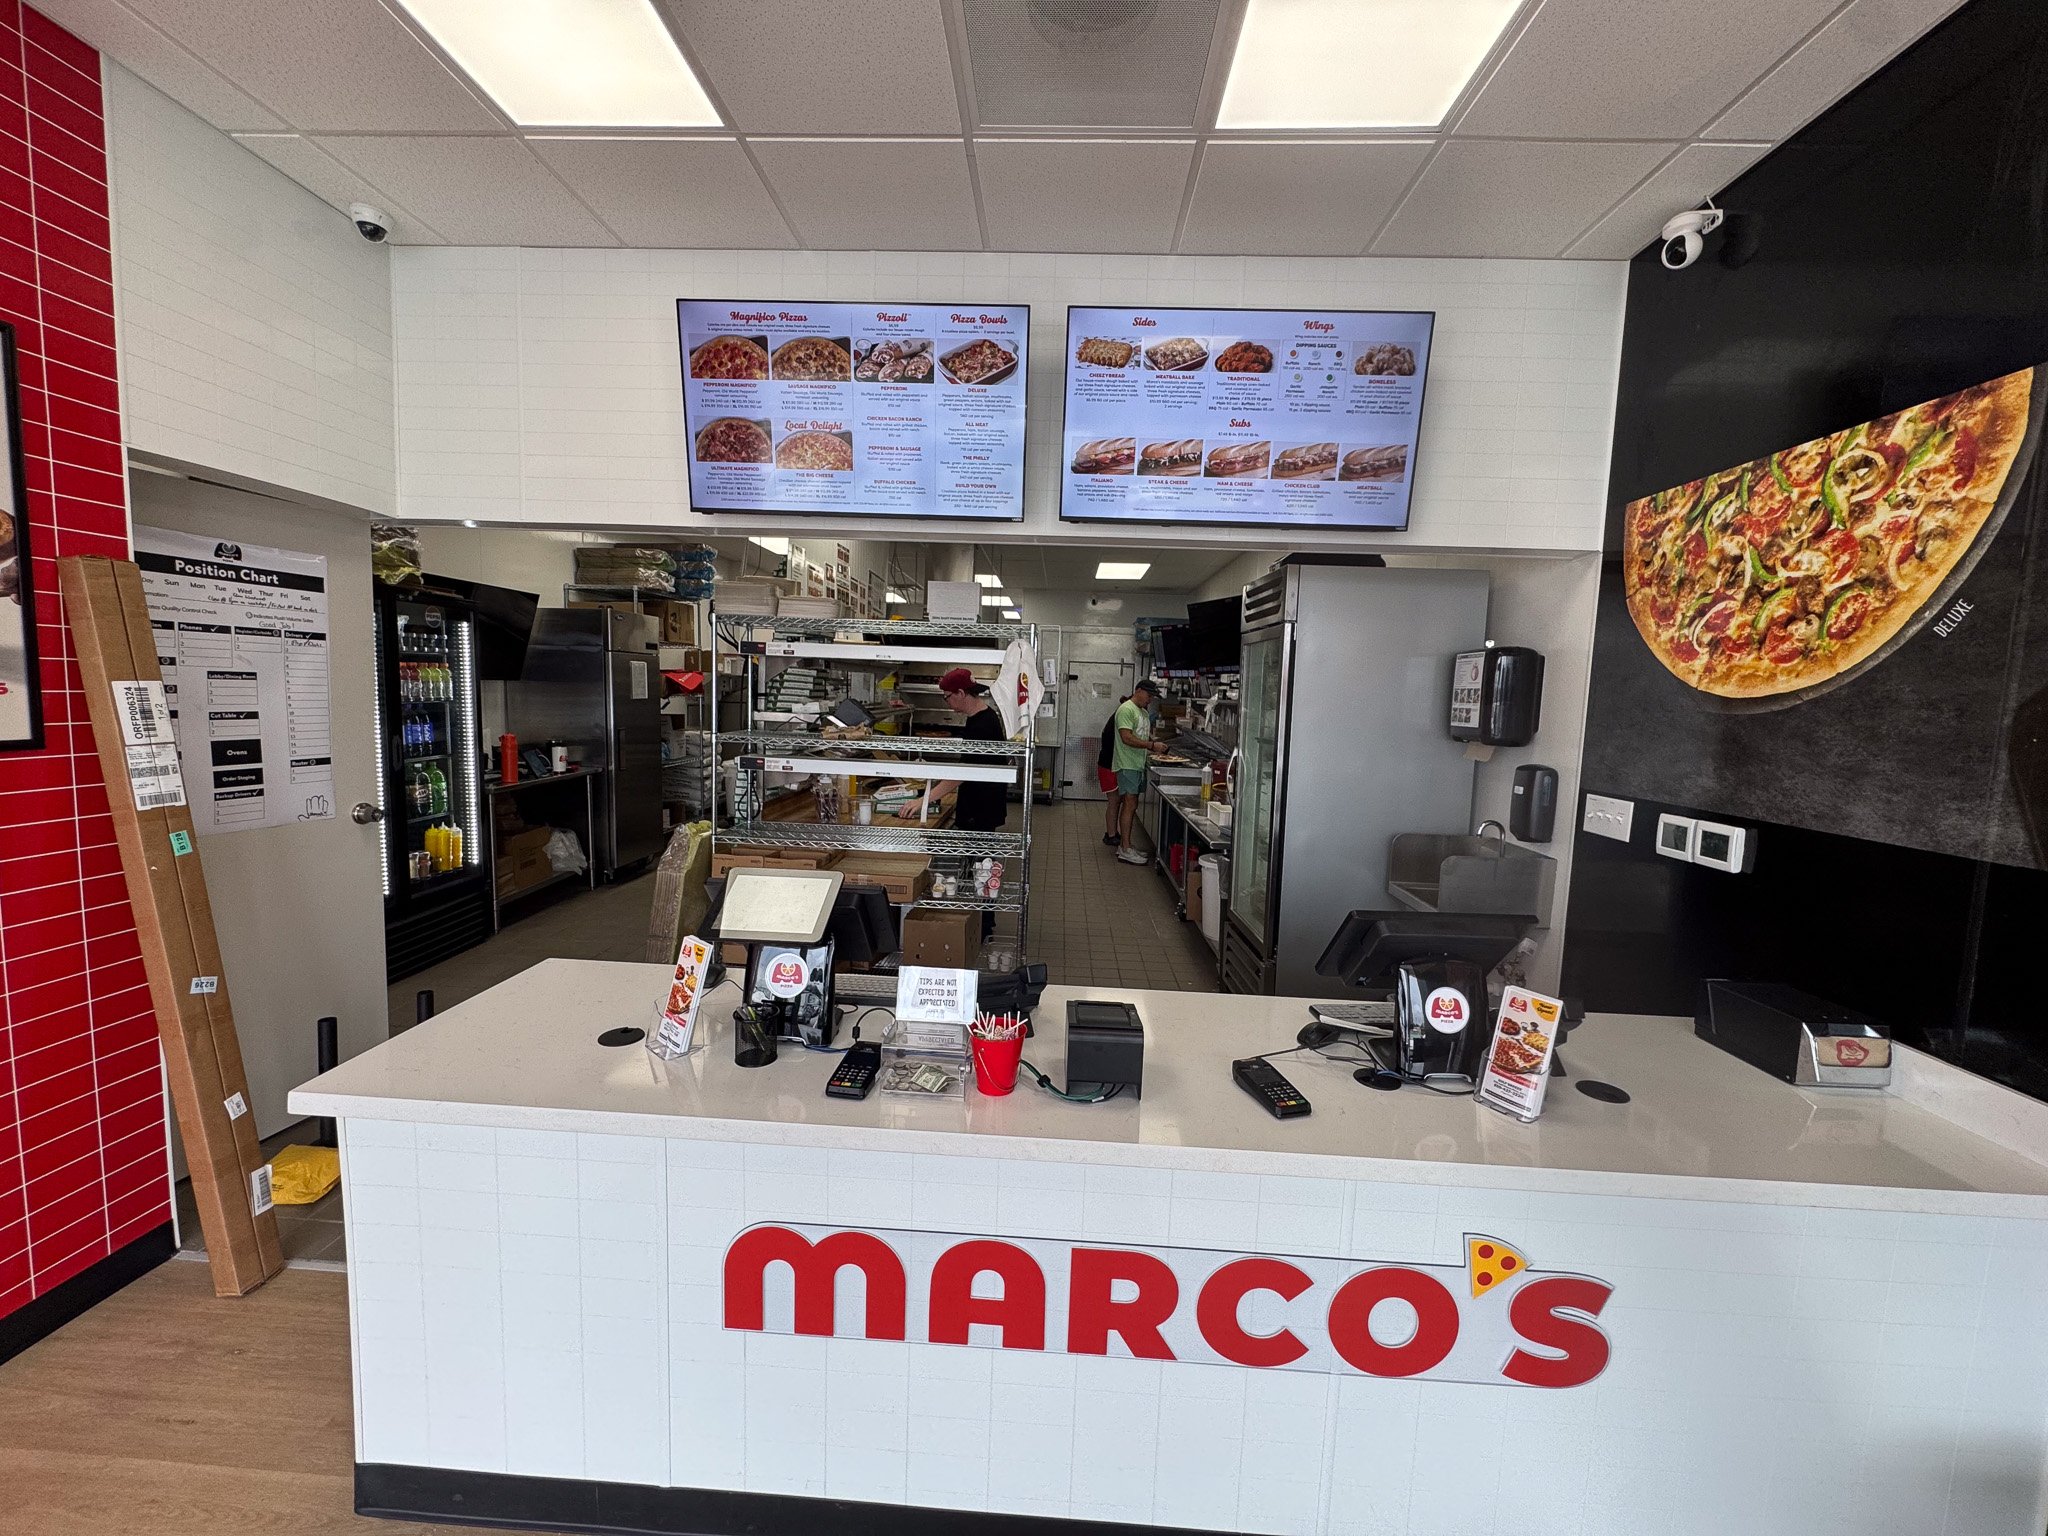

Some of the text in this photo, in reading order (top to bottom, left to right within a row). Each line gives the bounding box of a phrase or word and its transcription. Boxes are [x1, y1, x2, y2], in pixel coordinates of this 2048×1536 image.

[730, 311, 808, 324] Magnifico Pizzas
[951, 313, 1008, 324] Pizza Bowls
[1132, 316, 1157, 327] Sides
[1303, 320, 1335, 333] Wings
[785, 419, 843, 433] Local Delight
[1229, 418, 1251, 428] Subs
[174, 560, 279, 585] Position Chart
[164, 578, 179, 586] Sun
[214, 584, 226, 592] Tue
[1933, 598, 1974, 638] DELUXE
[124, 686, 144, 740] ORFP006324
[175, 833, 186, 850] B128
[919, 978, 933, 986] TIPS
[934, 978, 945, 986] ARE
[918, 988, 957, 997] EXPECTED BUT
[919, 999, 956, 1007] APPRECIATED
[722, 1224, 1615, 1388] MARCO'S
